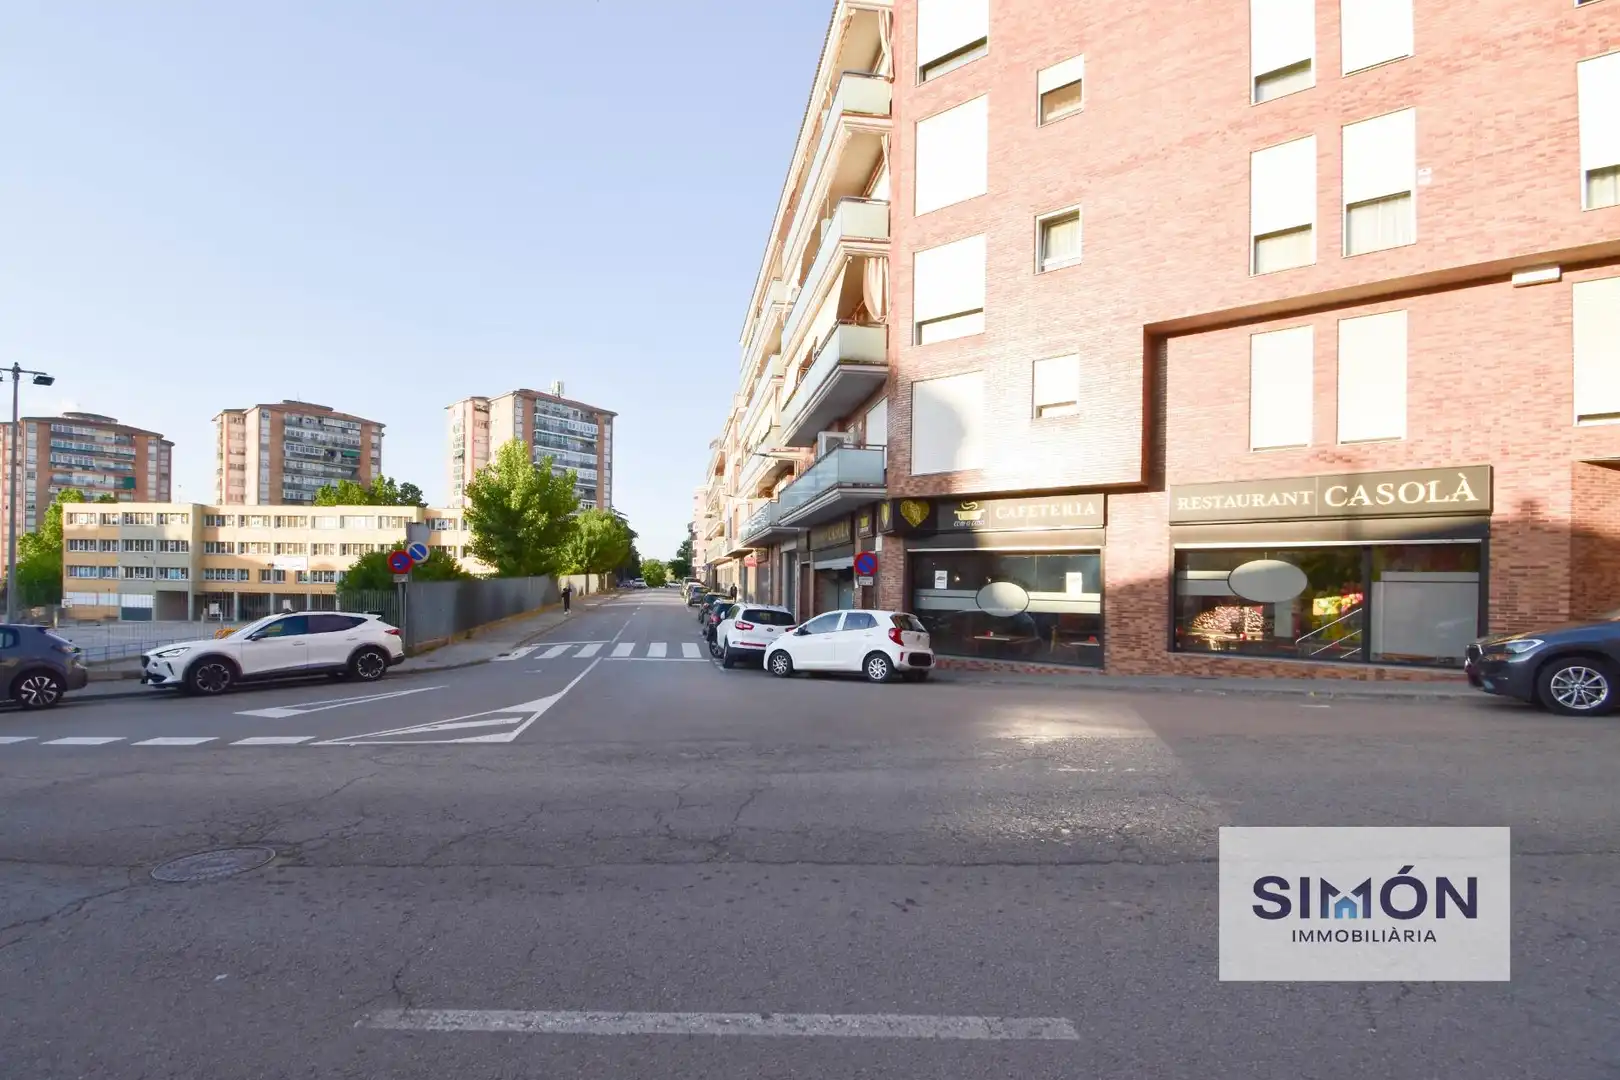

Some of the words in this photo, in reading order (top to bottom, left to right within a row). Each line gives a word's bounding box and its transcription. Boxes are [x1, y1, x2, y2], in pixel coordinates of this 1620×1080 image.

[1177, 491, 1314, 510] RESTAURANT
[1324, 472, 1479, 507] CASOLÀ
[996, 502, 1096, 519] CAFETERIA
